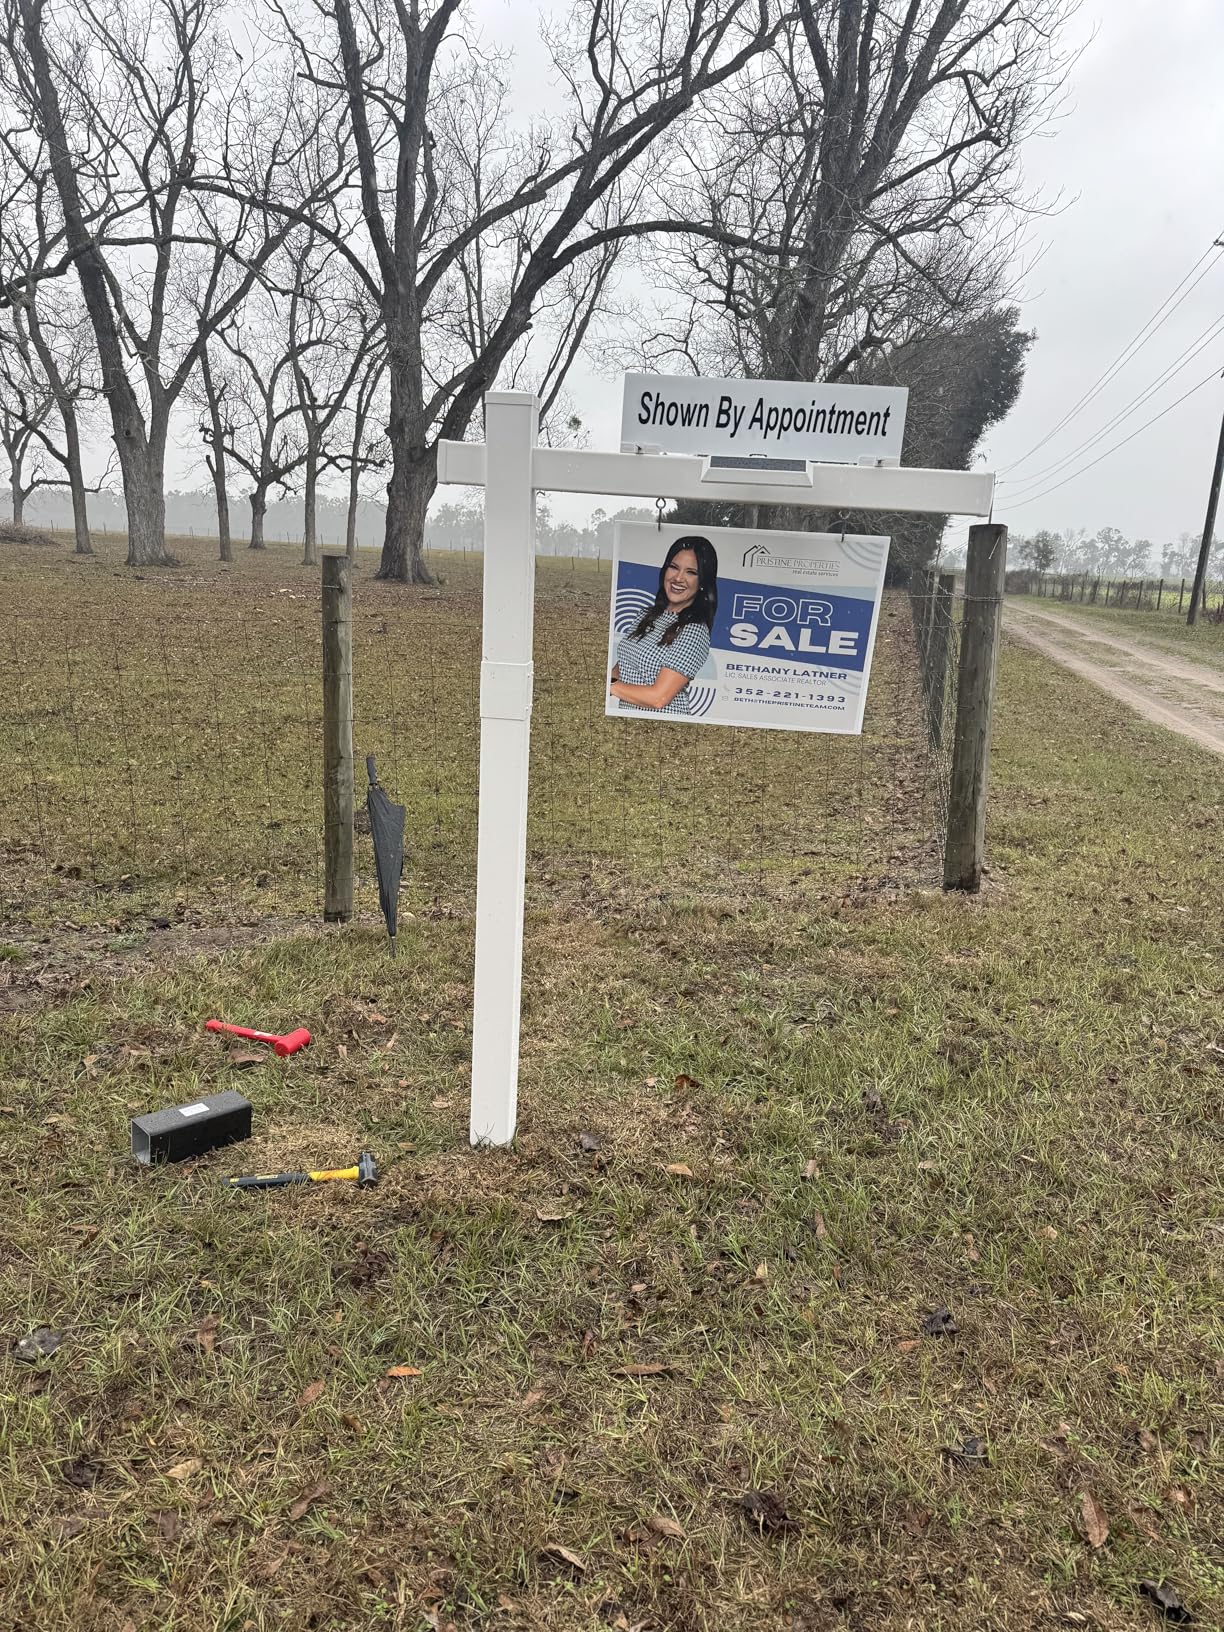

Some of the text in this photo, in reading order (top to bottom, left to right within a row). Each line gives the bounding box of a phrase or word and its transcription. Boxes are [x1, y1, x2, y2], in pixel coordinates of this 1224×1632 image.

[638, 391, 891, 440] Shown By Appointment
[756, 557, 840, 570] PRISTINE PROPERTIES
[732, 593, 834, 626] FOR
[729, 622, 859, 656] SALE
[726, 663, 848, 680] BETHANY LATNER
[738, 672, 758, 681] SALES
[759, 674, 795, 684] ASSOCIATE
[796, 677, 827, 686] REALTOR
[735, 687, 846, 703] 352-221-1393
